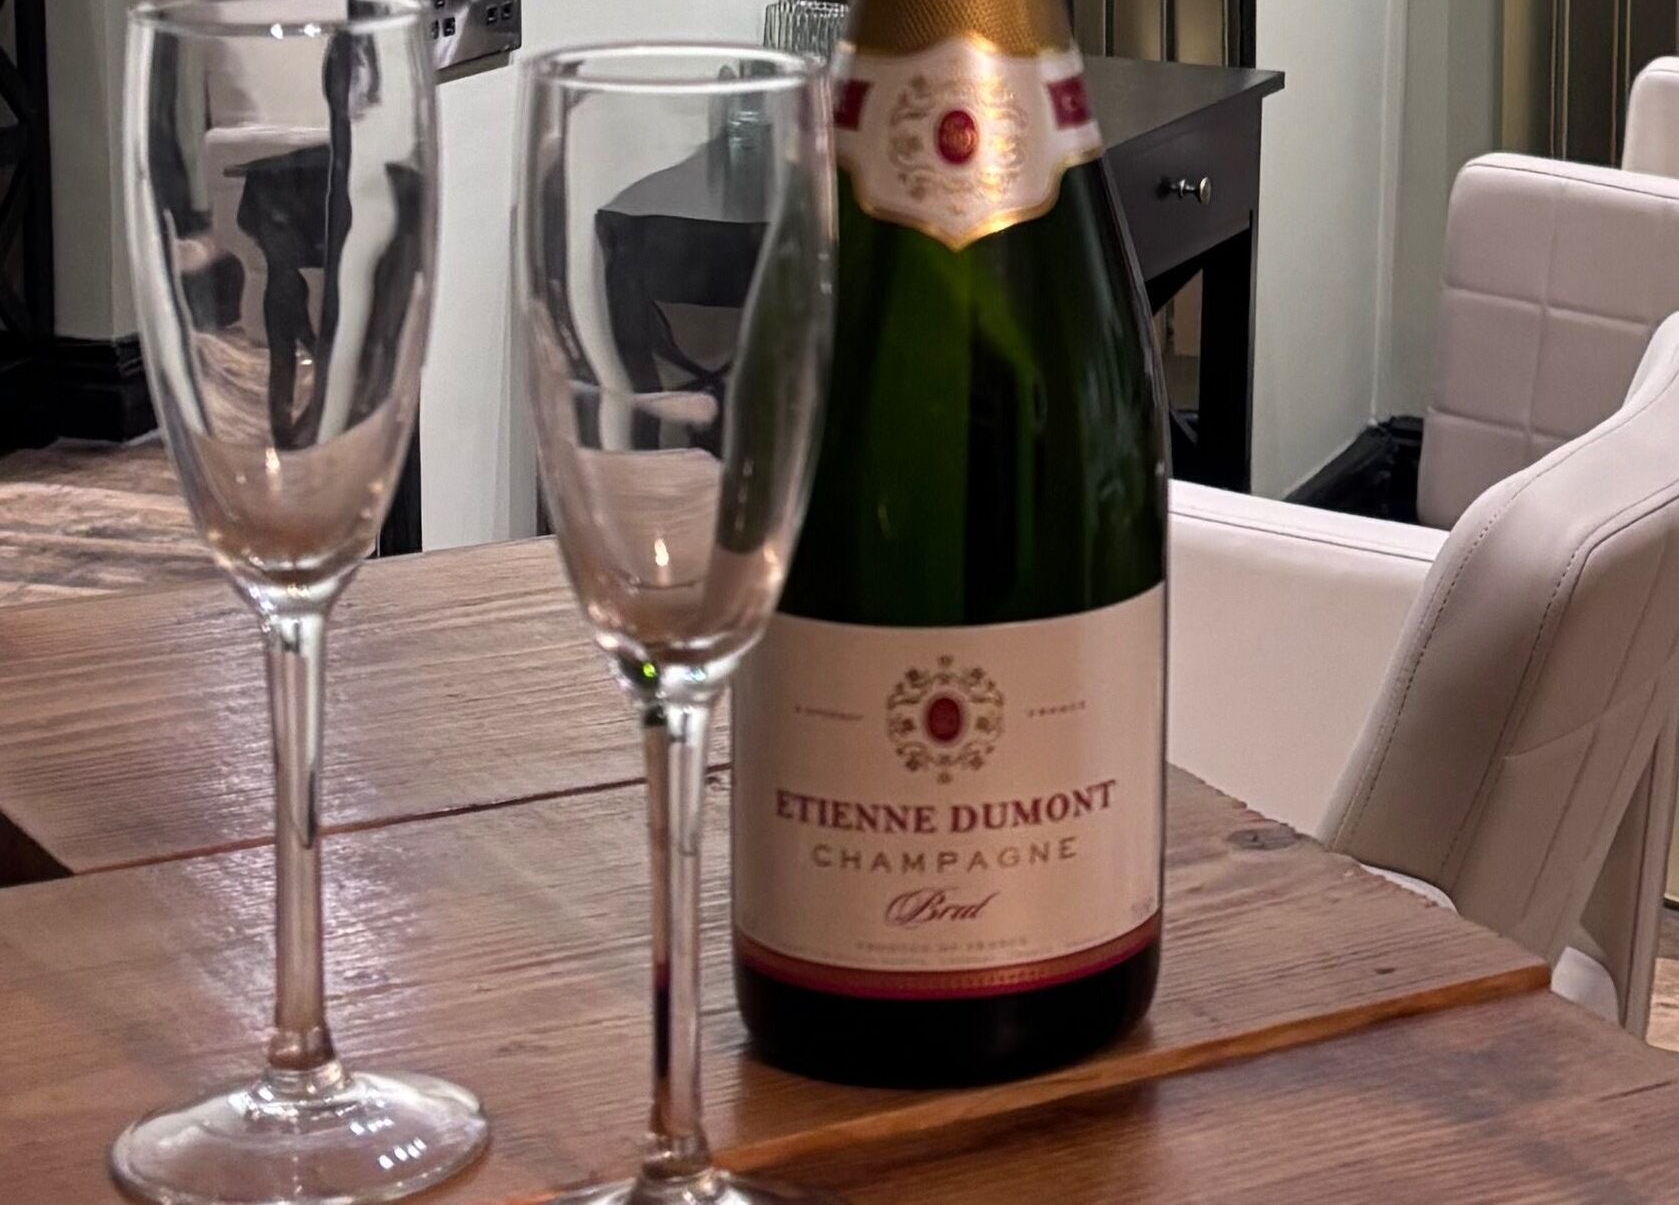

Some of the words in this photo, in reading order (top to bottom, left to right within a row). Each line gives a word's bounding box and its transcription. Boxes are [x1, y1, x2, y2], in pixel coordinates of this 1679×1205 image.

[776, 789, 937, 834] ETIENNE
[950, 780, 1116, 833] DUMONT
[811, 837, 1078, 873] CHAMPAGNE
[885, 887, 1000, 929] Brut
